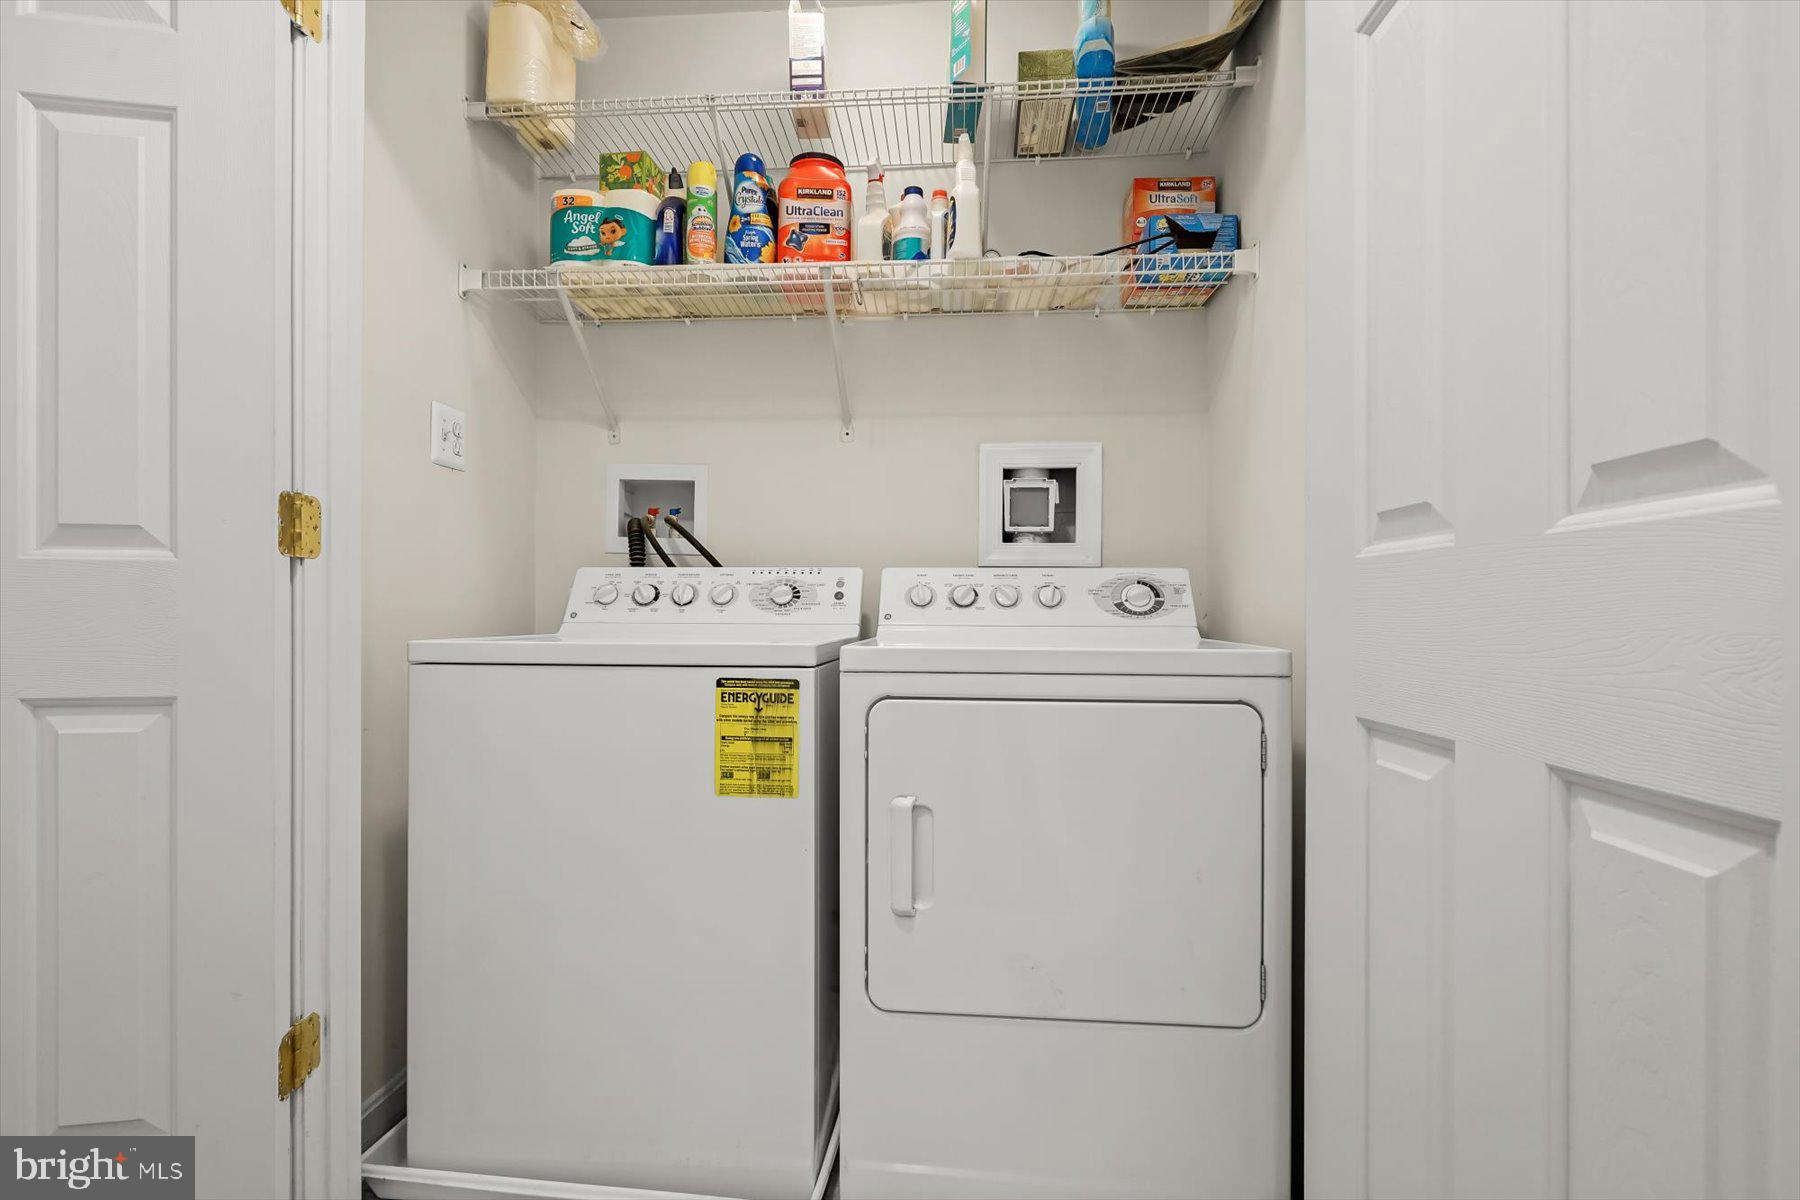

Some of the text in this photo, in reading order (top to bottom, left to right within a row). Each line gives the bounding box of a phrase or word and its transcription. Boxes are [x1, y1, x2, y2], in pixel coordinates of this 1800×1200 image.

[741, 186, 757, 194] Purex
[562, 196, 575, 205] 32
[1149, 194, 1198, 204] UltraSoft
[563, 210, 603, 224] Angel
[785, 205, 844, 217] UltraClean
[571, 221, 596, 234] Soft
[720, 692, 794, 704] ENERGYGUIDE
